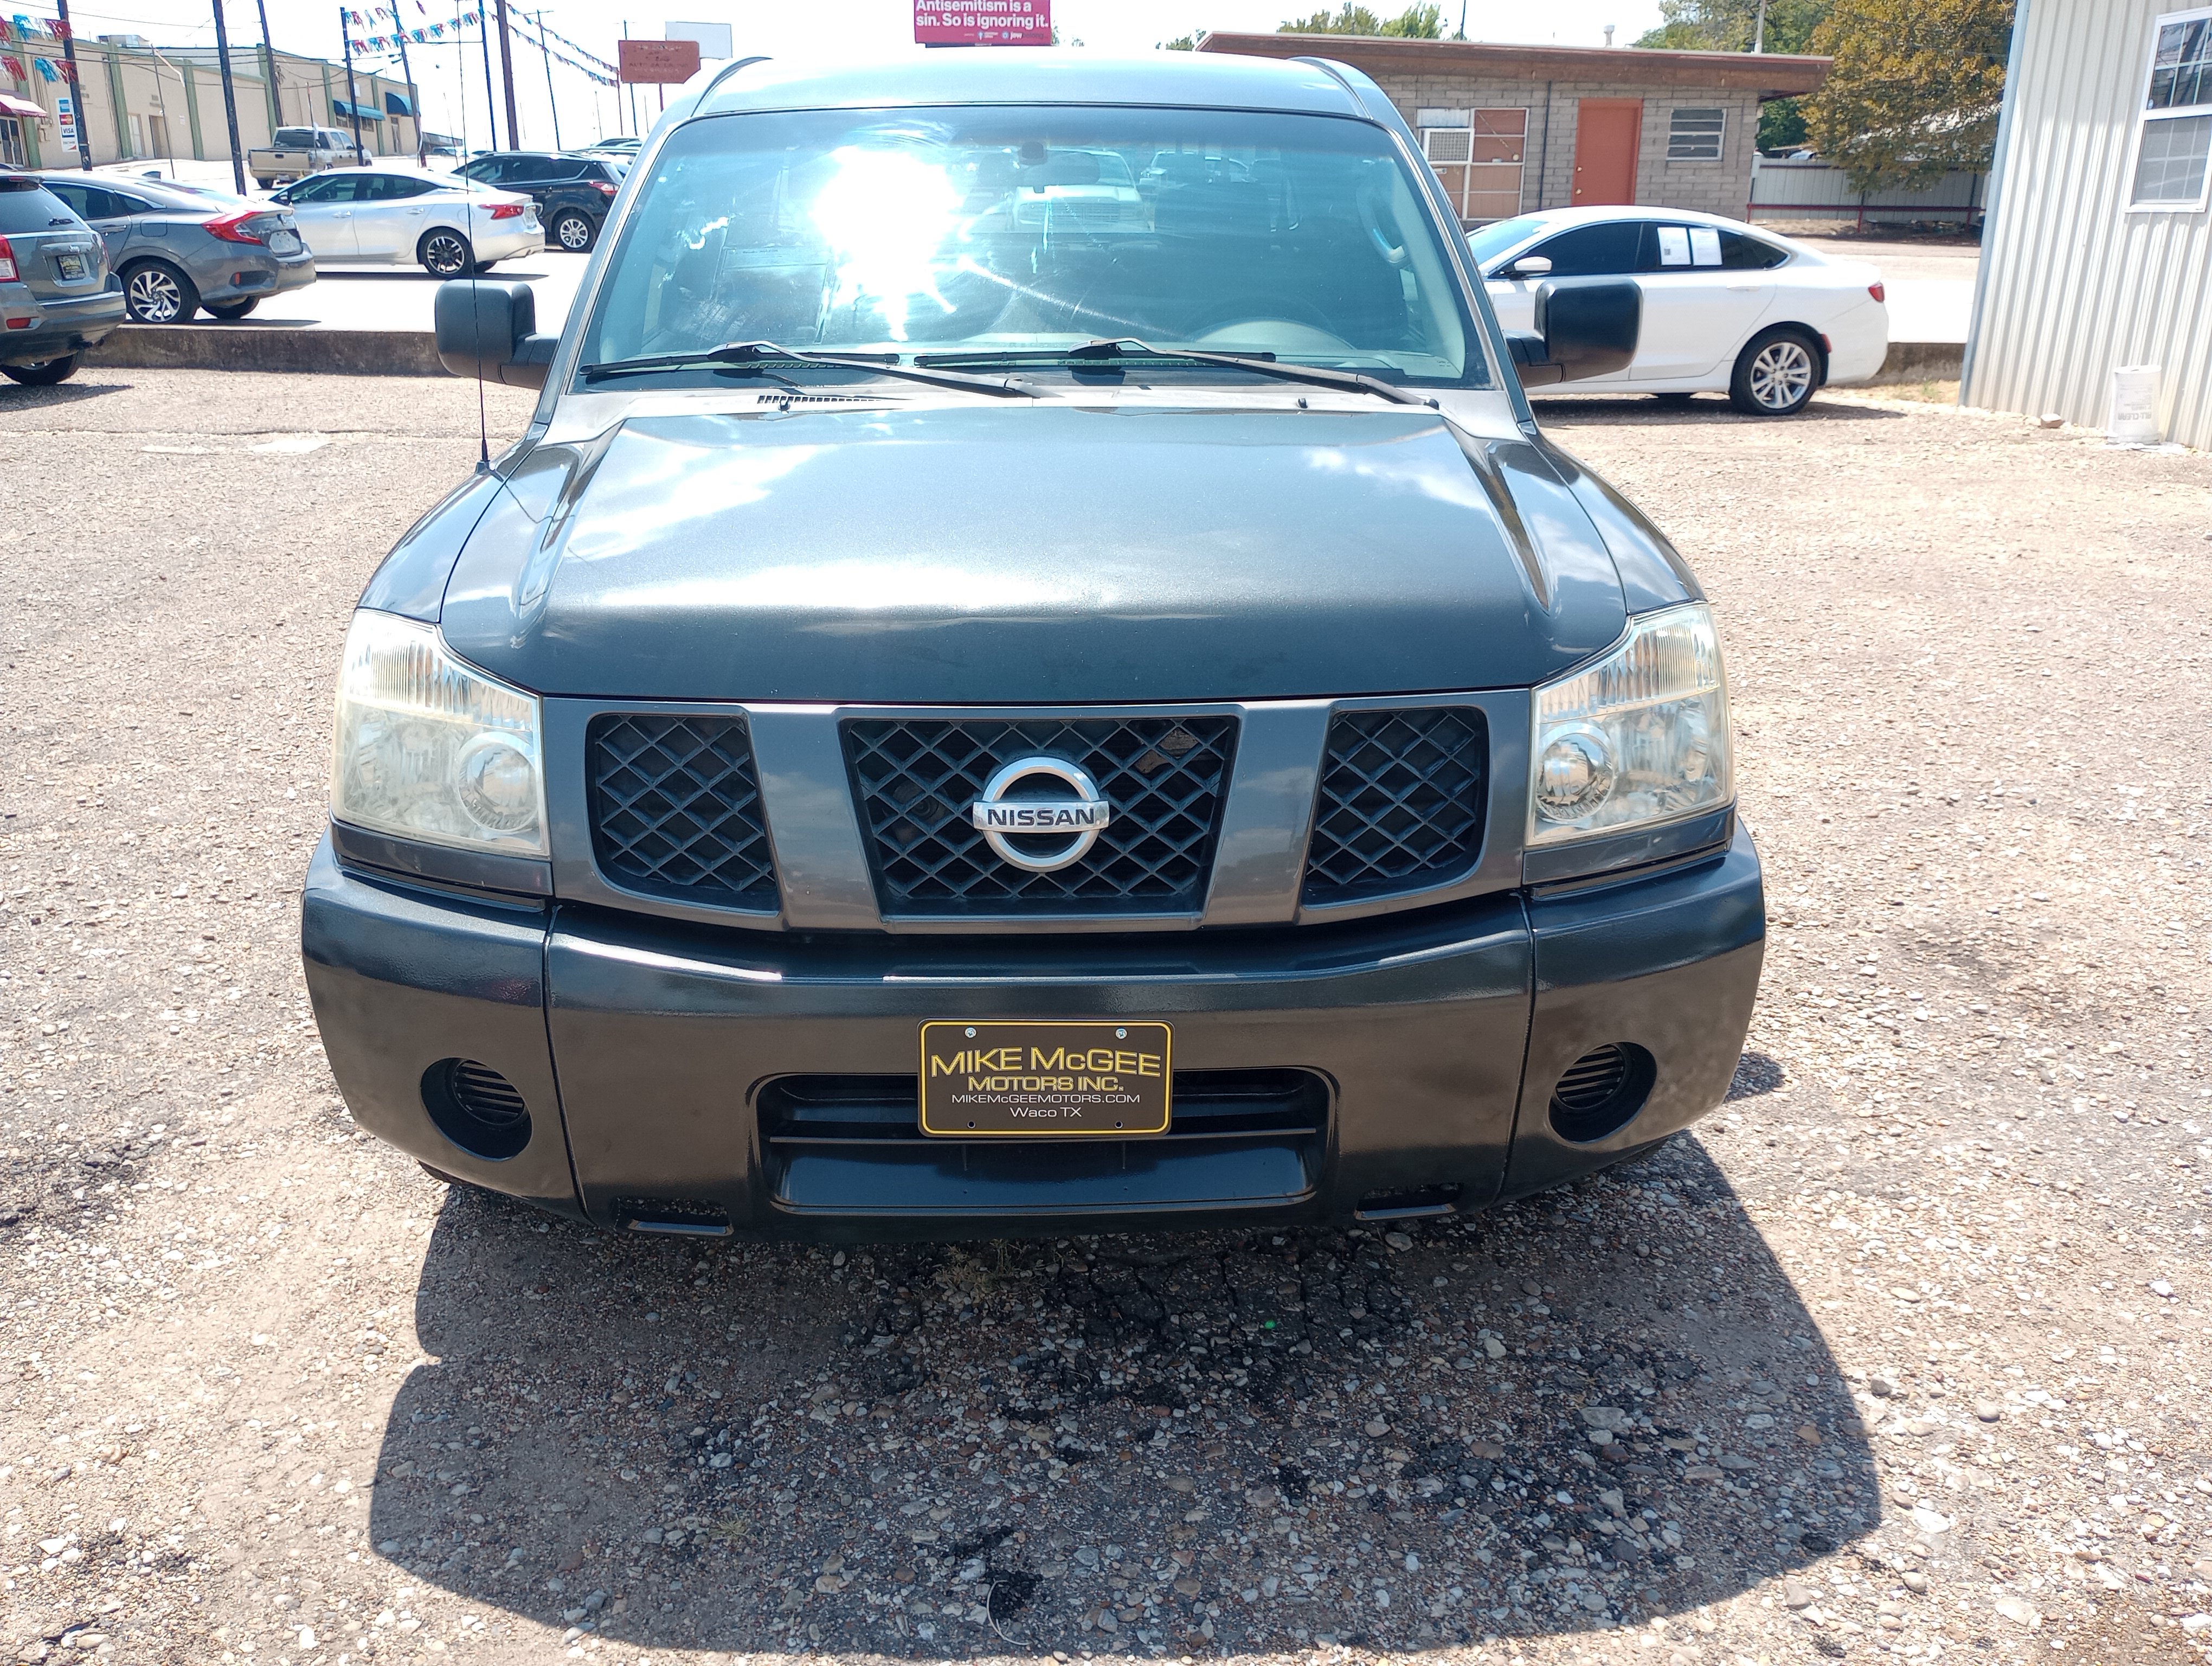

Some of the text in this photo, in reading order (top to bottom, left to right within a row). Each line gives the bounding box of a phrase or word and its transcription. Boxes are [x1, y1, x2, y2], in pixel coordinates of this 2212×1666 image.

[916, 0, 1032, 12] Antisemitism is a
[916, 12, 1049, 30] sin. So is ignoring it.
[987, 809, 1094, 826] NISSAN
[931, 1047, 1160, 1077] MIKE McGEE
[968, 1076, 1124, 1091] MOTORS INC.
[1010, 1107, 1082, 1117] Waco TX
